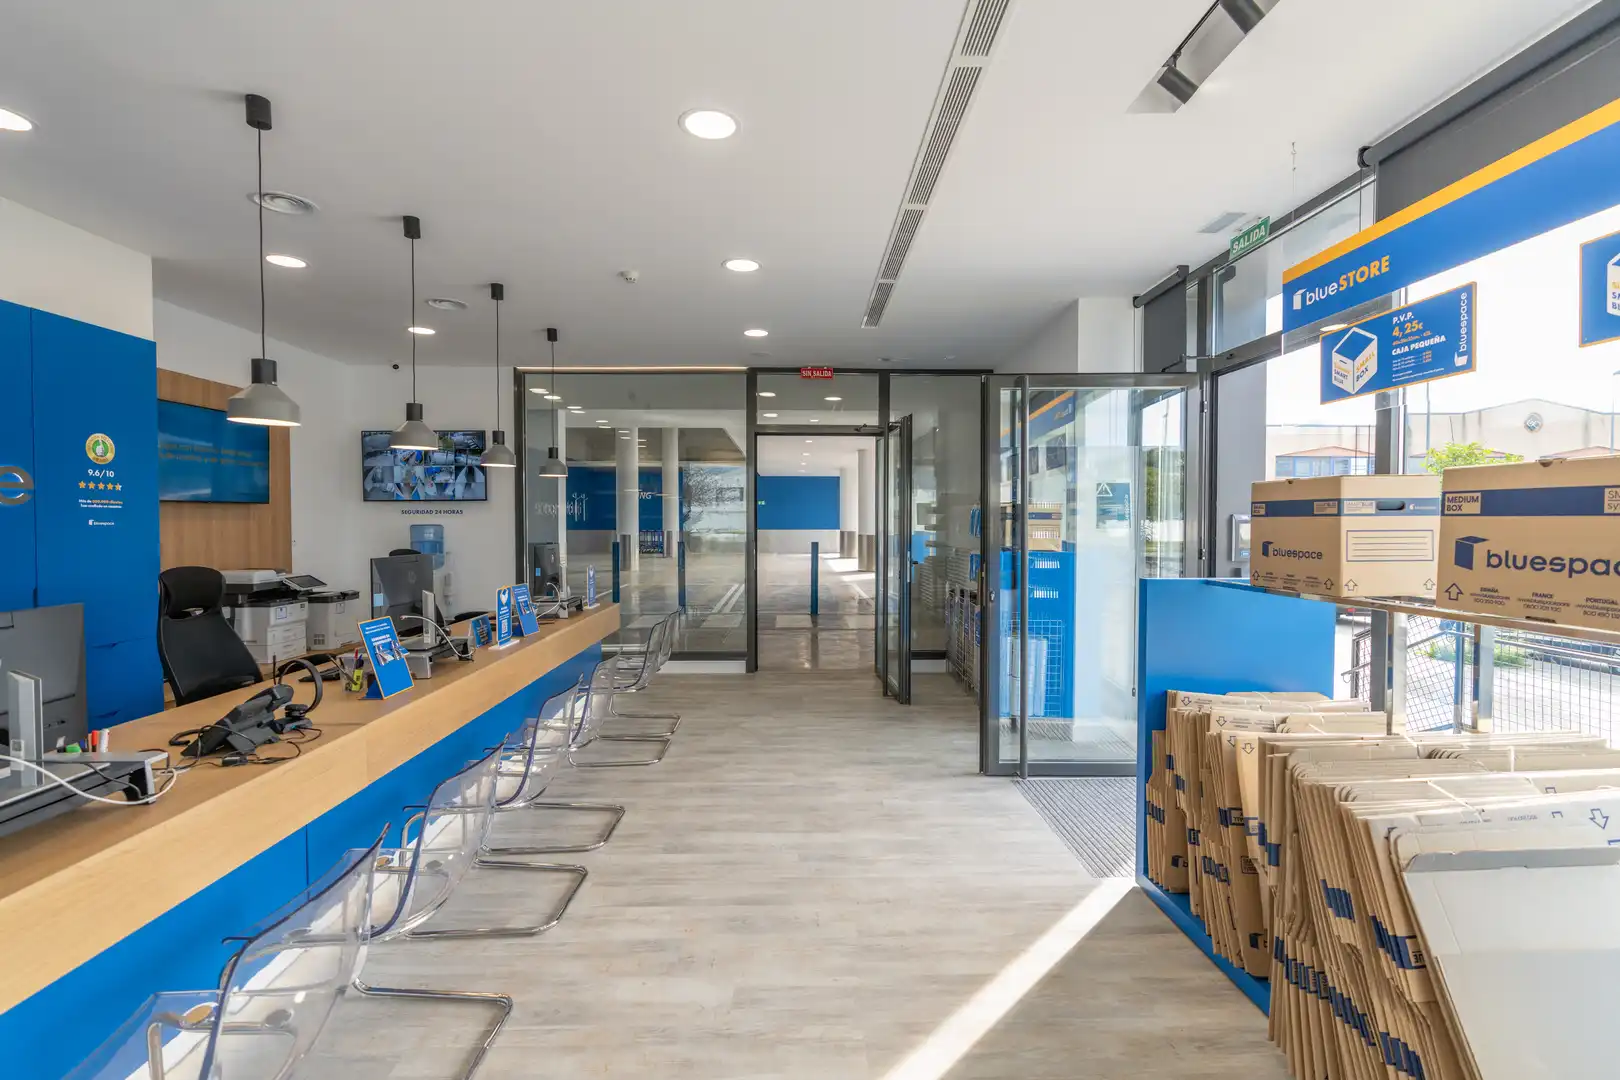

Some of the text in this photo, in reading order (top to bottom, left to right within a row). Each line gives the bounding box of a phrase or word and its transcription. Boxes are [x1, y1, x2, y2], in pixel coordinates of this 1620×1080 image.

[1232, 225, 1265, 253] SALIDA
[1306, 255, 1390, 305] blueSTORE
[1392, 311, 1414, 325] P.V.P.
[1459, 292, 1468, 352] bluespace
[1392, 345, 1409, 356] CAJA
[1410, 335, 1447, 351] PEQUEÑA
[1356, 365, 1369, 382] BOX
[1446, 495, 1479, 504] MEDIUM
[1446, 504, 1463, 512] BOX
[1272, 548, 1323, 561] bluespace
[1531, 591, 1554, 599] FRANCE
[1585, 597, 1618, 605] PORTUGAL
